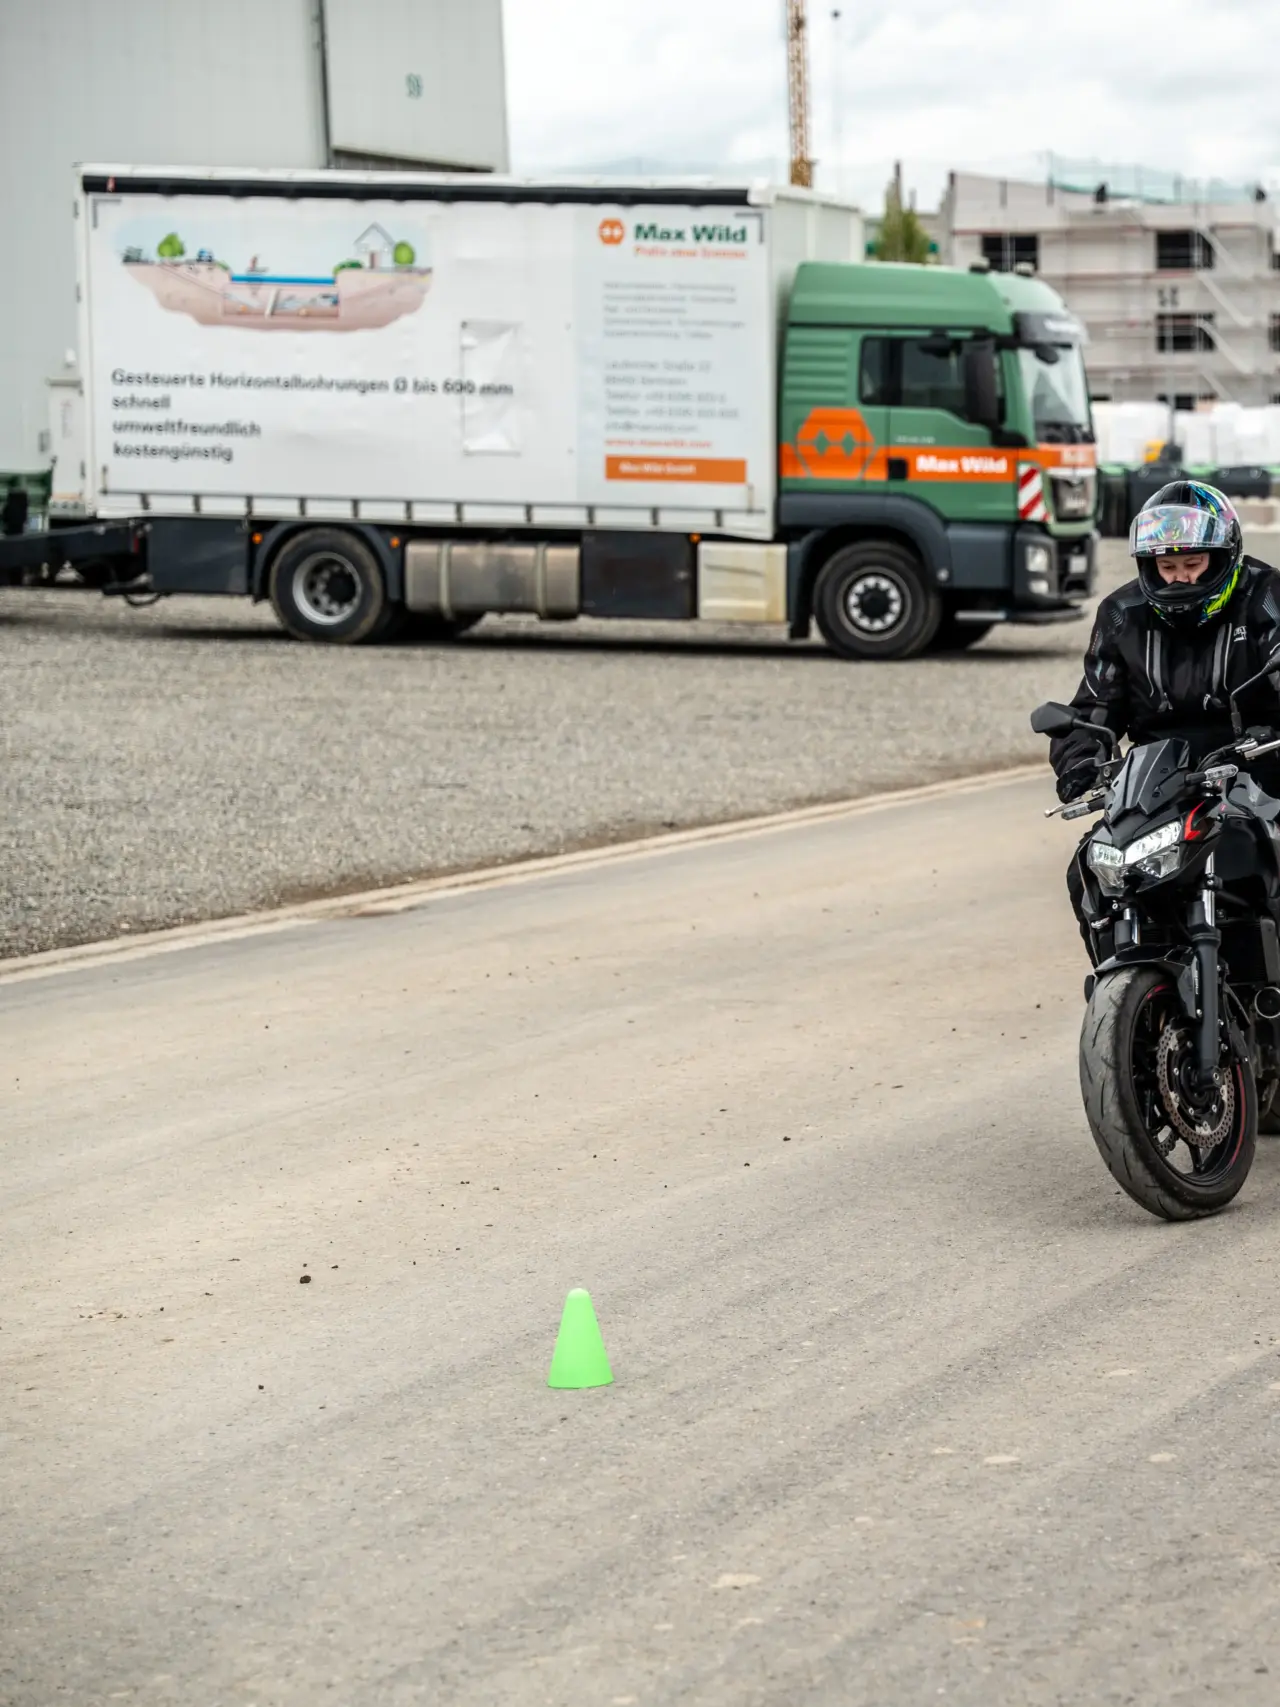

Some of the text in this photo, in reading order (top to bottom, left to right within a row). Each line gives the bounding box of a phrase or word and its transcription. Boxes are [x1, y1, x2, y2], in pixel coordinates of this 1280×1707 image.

[635, 223, 747, 242] Max Wild
[112, 368, 205, 387] Gesteuerte
[210, 372, 389, 396] Horizontalbohrungen
[412, 377, 438, 395] bis
[442, 378, 475, 395] 600
[479, 382, 513, 396] mm
[112, 394, 171, 409] schnell
[113, 418, 261, 437] umweltfreundlich
[113, 441, 233, 464] kostengünstig
[916, 455, 1008, 473] Max Wild
